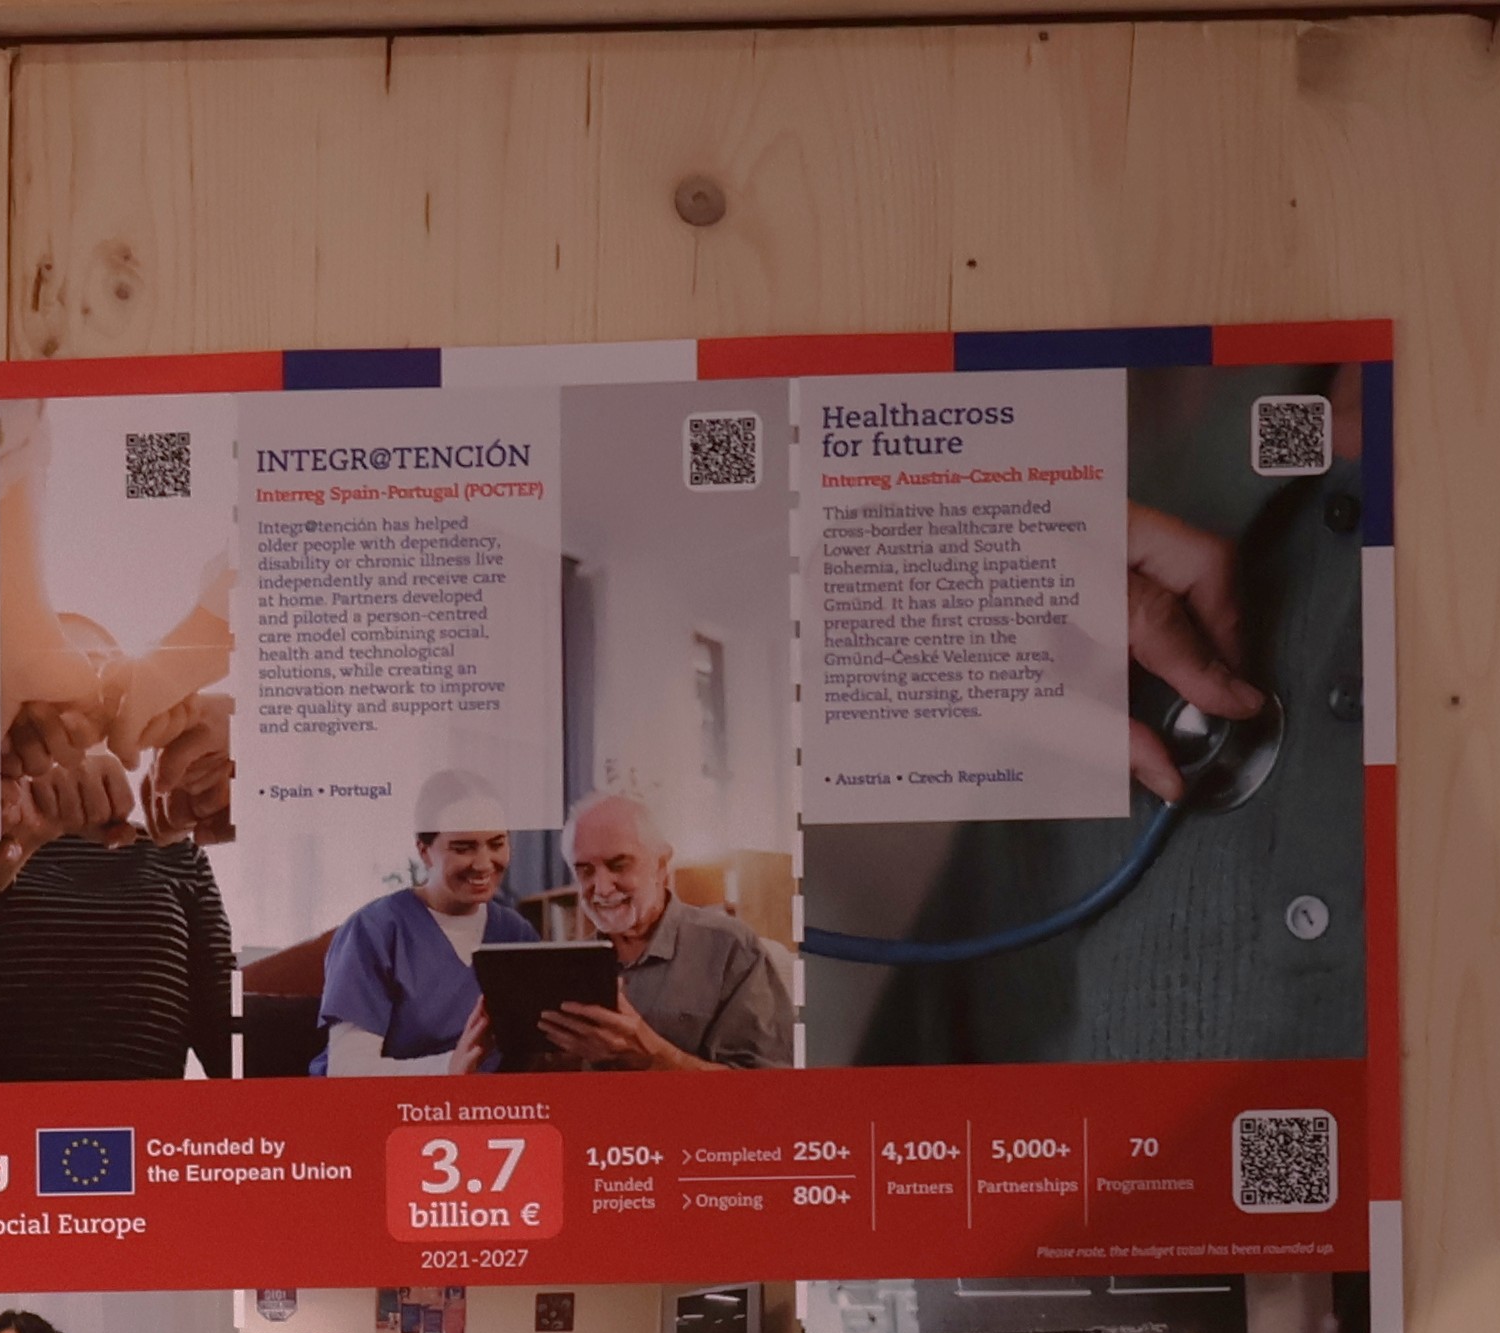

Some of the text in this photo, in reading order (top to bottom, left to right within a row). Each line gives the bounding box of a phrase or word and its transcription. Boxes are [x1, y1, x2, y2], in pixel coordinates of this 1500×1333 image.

[821, 401, 1014, 429] Healthacross
[256, 438, 531, 473] INTEGR@TENCIÓN
[821, 430, 963, 458] for future
[256, 480, 547, 507] Interreg Spain-Portugal (POCTEP)
[834, 768, 1024, 787] Austria Czech Republic
[586, 1145, 664, 1171] 1,050+
[880, 1140, 961, 1165] 4,100+
[991, 1138, 1071, 1163] 5,000+
[1129, 1137, 1159, 1157] 70
[421, 1138, 525, 1194] 3.7
[792, 1184, 851, 1206] 800+
[57, 1213, 146, 1240] Europe
[408, 1200, 540, 1228] billion €
